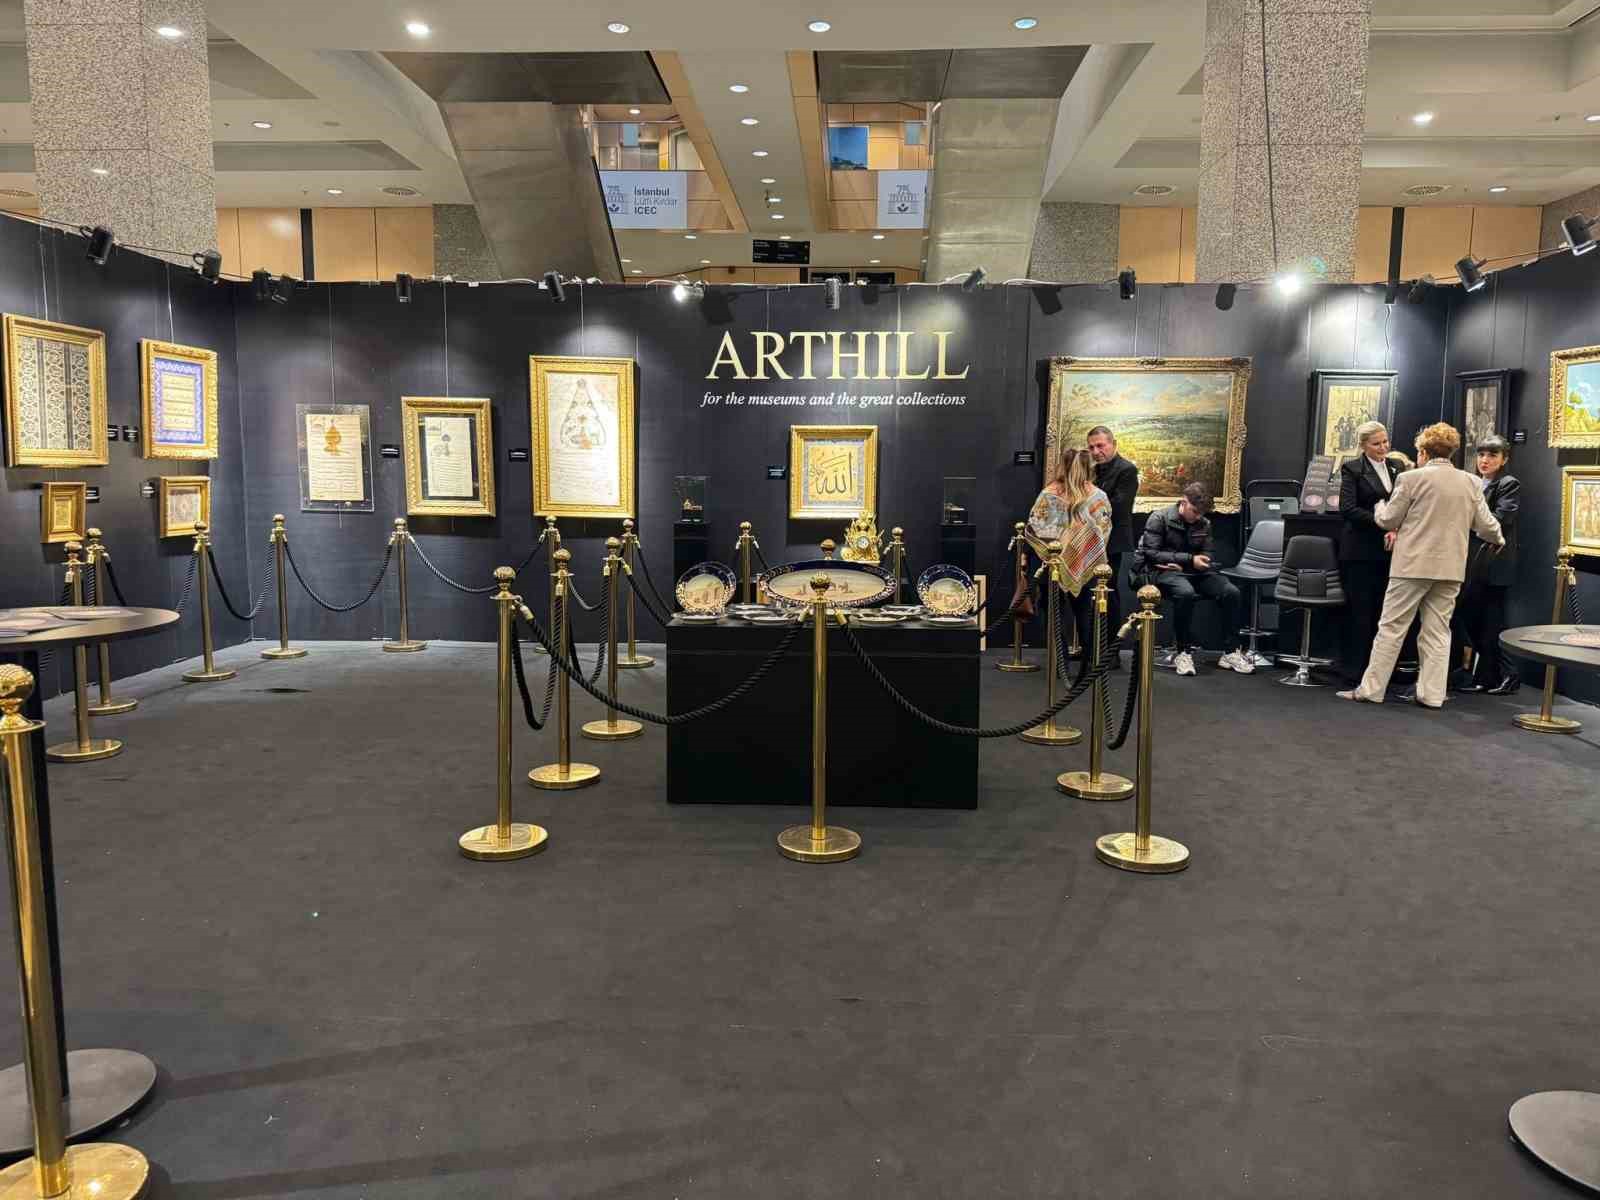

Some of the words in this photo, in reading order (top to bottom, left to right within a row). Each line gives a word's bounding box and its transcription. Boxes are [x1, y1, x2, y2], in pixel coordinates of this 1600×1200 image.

[634, 206, 657, 215] ICEC
[704, 330, 970, 380] ARTHILL
[701, 392, 722, 407] for
[725, 392, 745, 405] the
[747, 395, 806, 406] museums
[808, 392, 835, 406] and
[836, 392, 857, 406] the
[858, 394, 894, 408] great
[896, 392, 967, 406] collections
